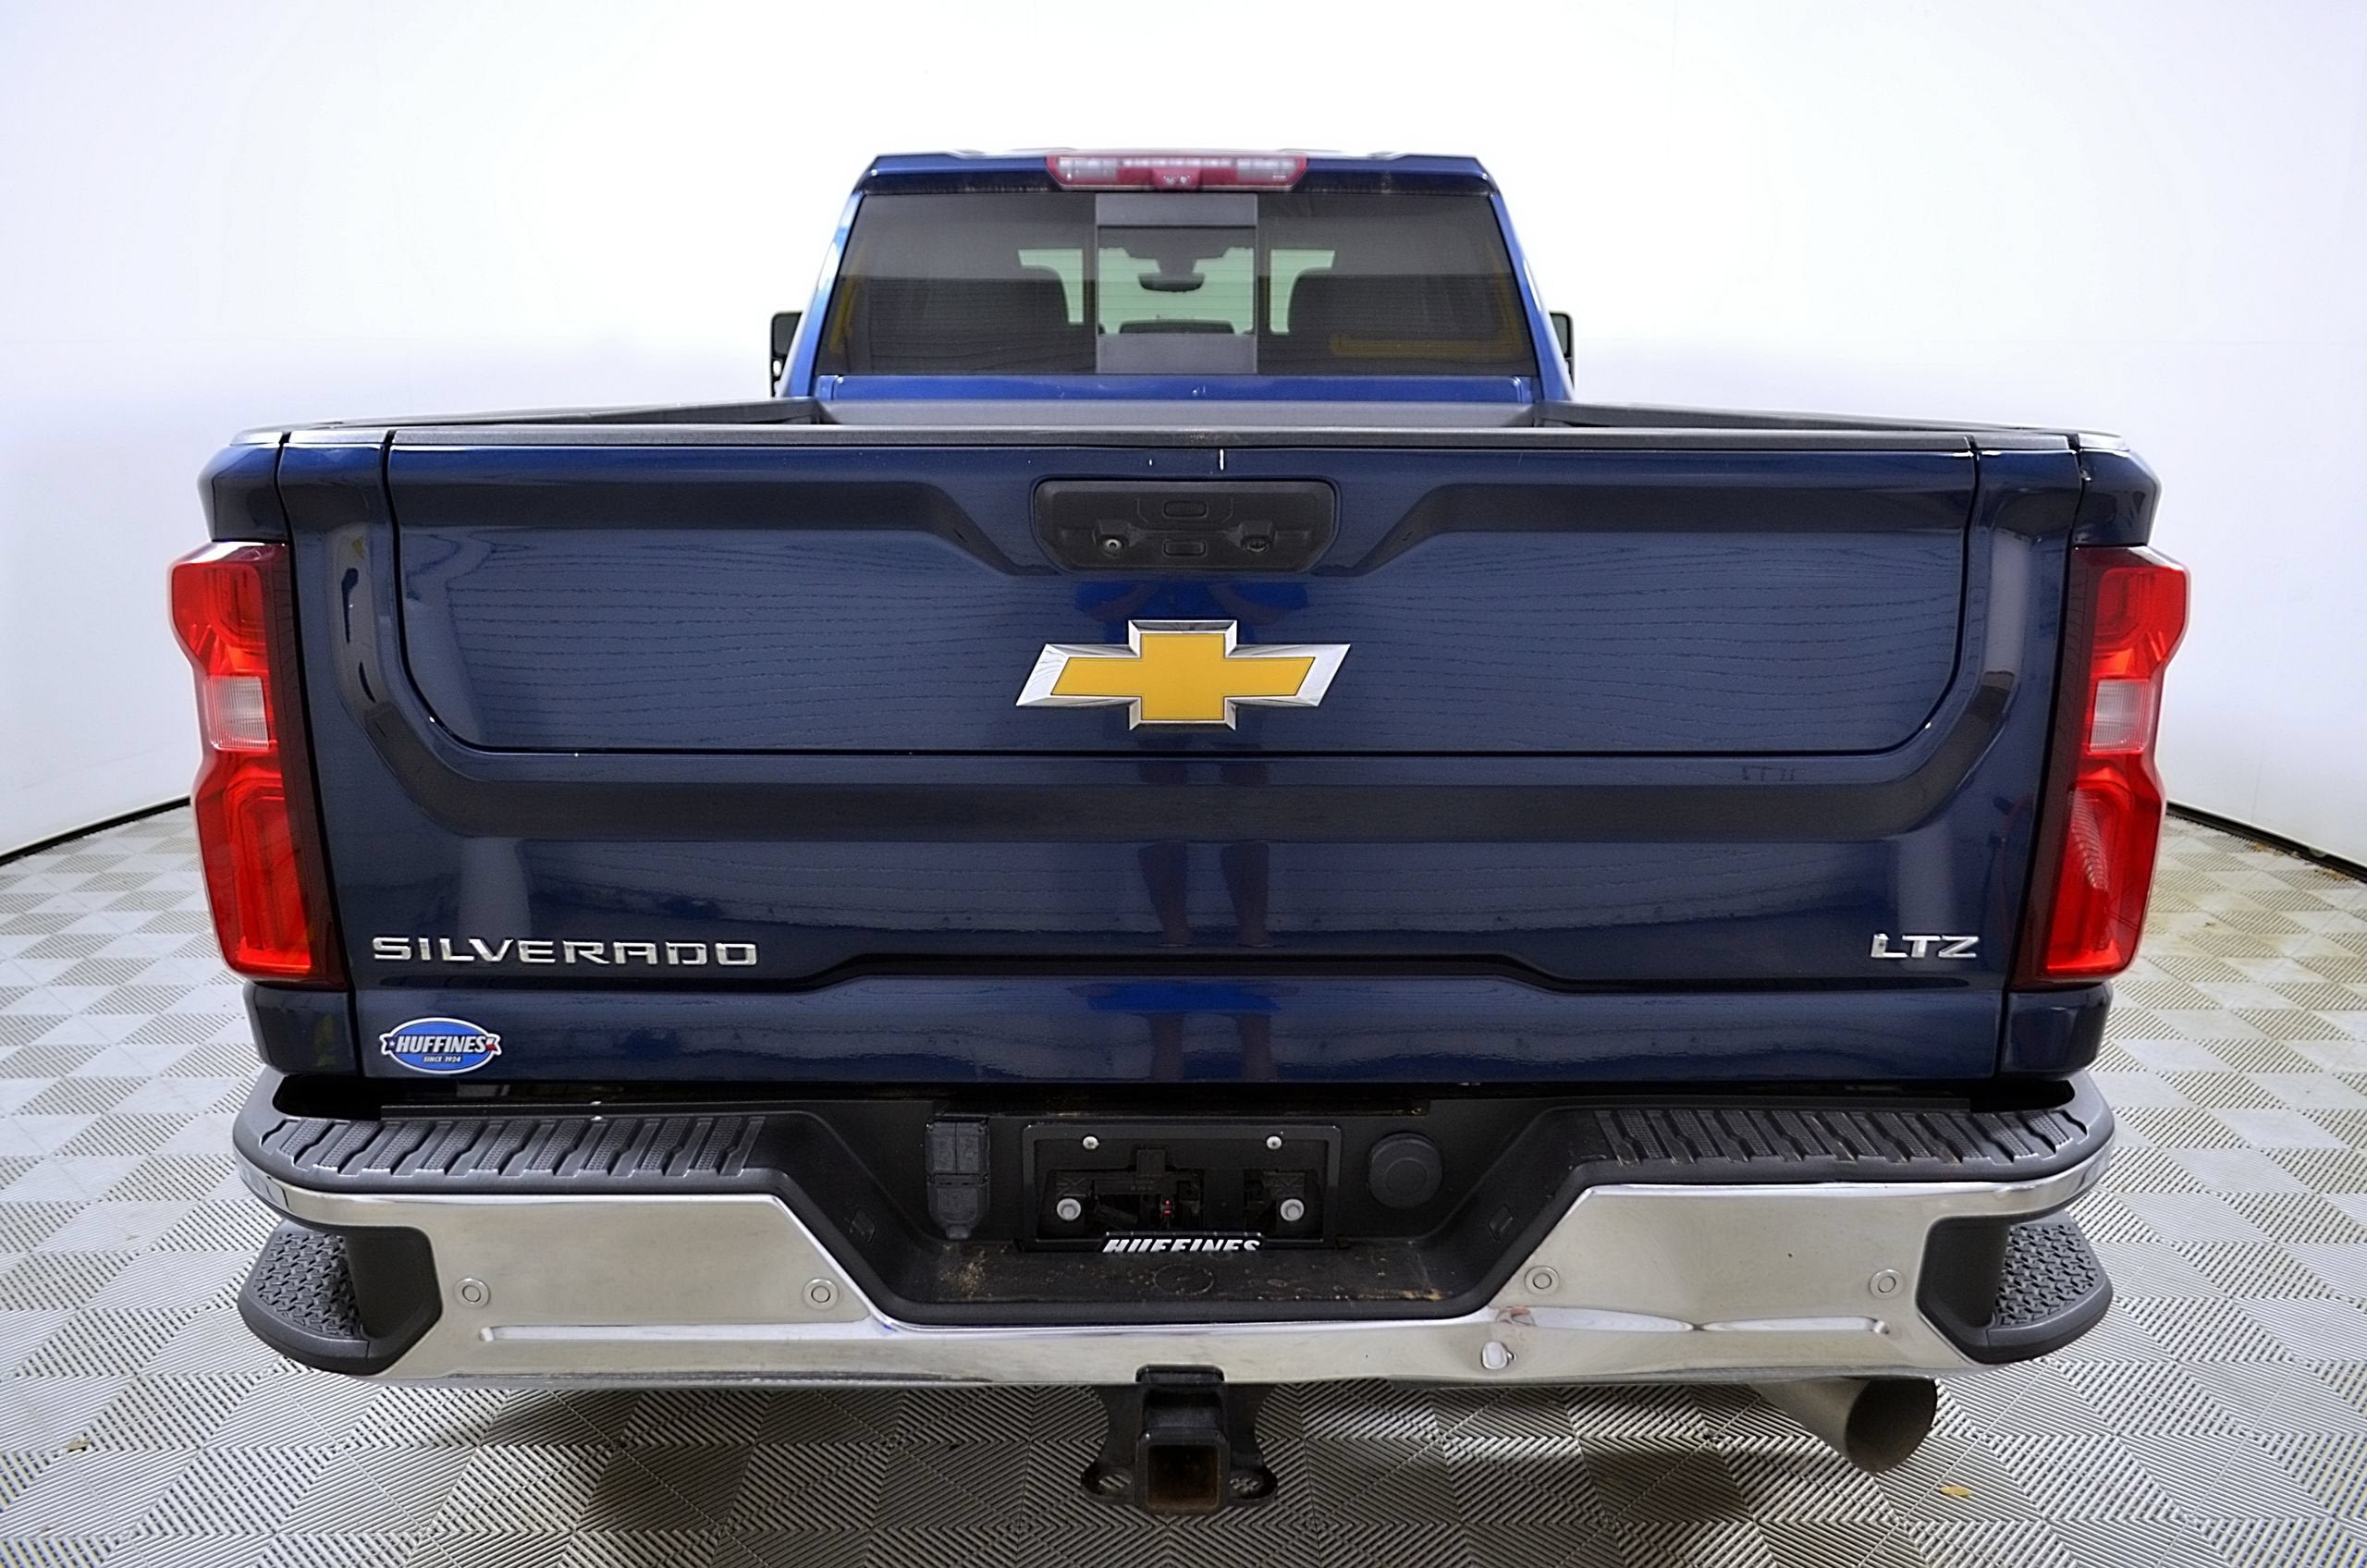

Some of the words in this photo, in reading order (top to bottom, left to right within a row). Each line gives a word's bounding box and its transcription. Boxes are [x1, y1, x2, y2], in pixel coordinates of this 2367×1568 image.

[372, 937, 758, 966] SILVERADO
[1870, 933, 1980, 959] LTZ
[395, 1035, 486, 1053] HUFFINES
